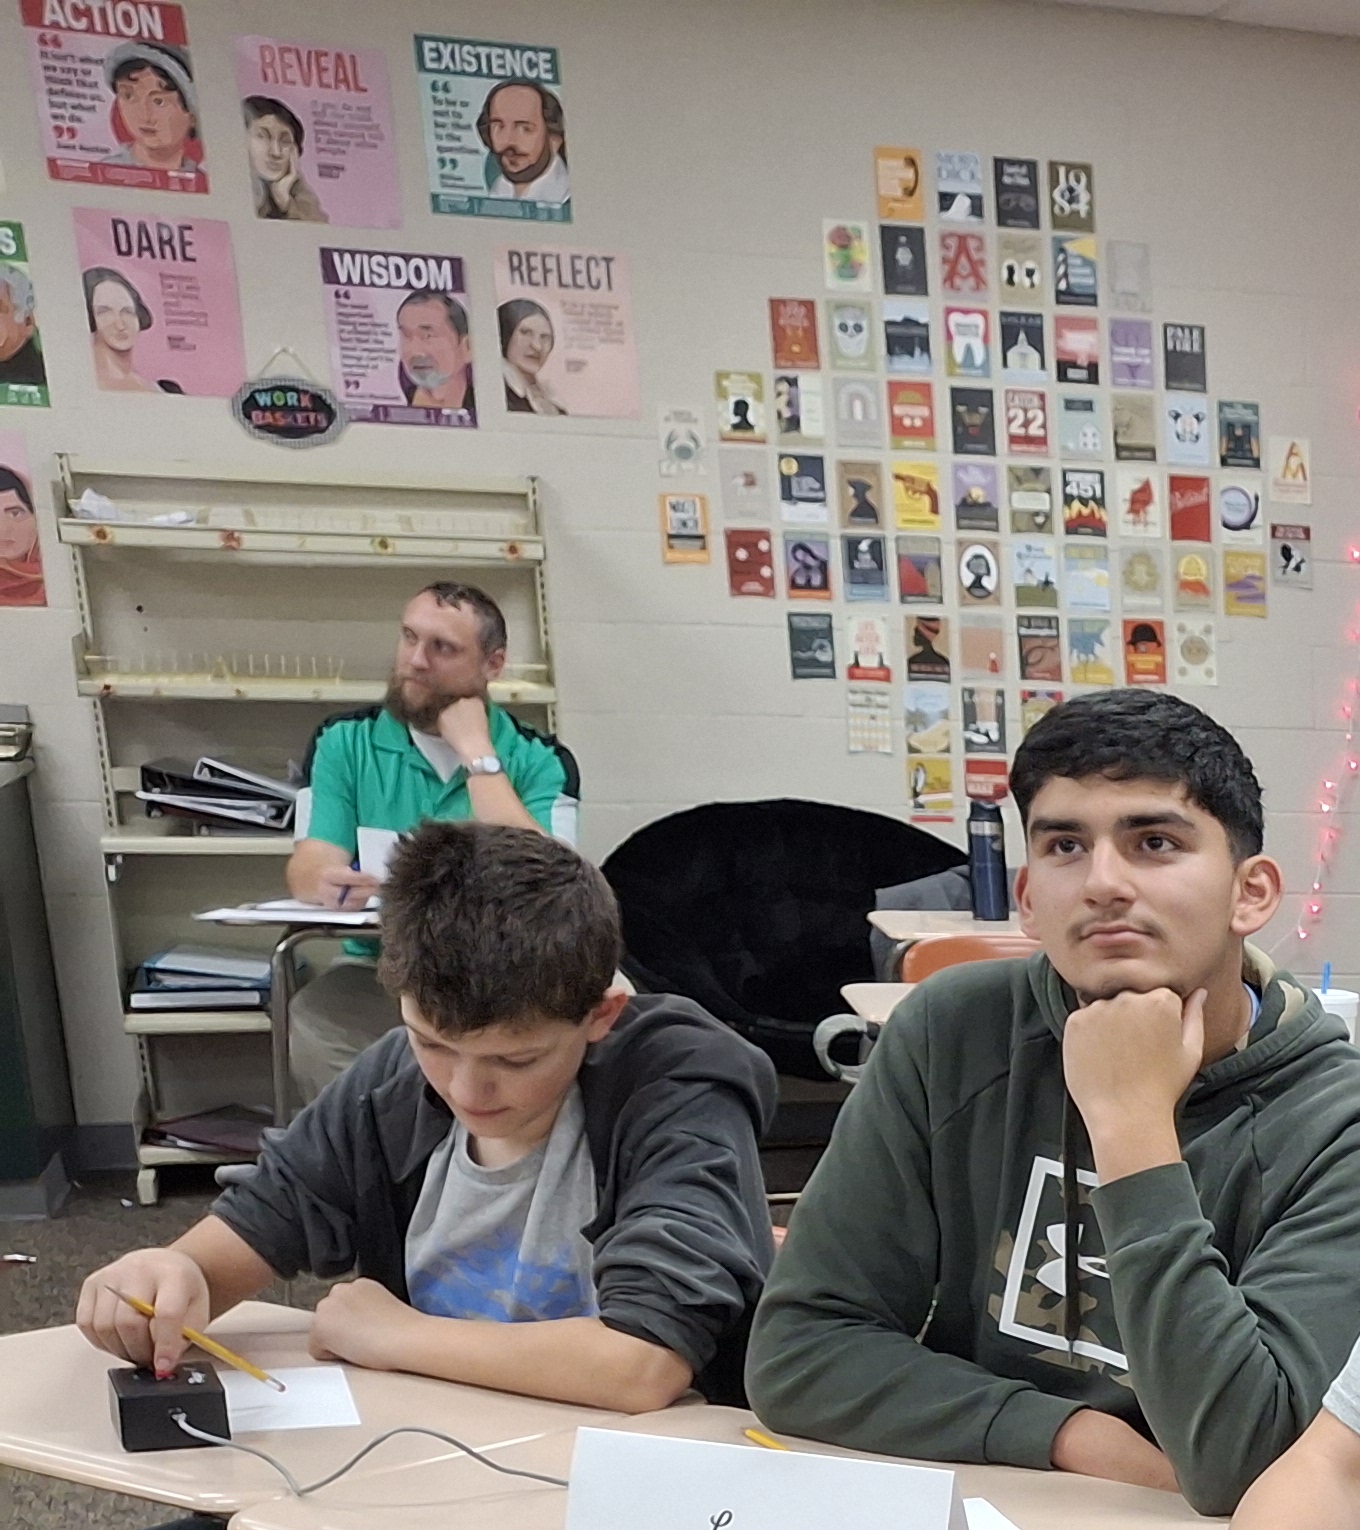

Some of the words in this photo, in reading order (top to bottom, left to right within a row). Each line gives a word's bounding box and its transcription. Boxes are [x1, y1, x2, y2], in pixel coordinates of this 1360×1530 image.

[44, 0, 164, 40] ACTION
[259, 44, 368, 92] REVEAL
[422, 40, 554, 79] EXISTENCE
[111, 218, 197, 263] DARE
[332, 251, 454, 290] WISDOM
[507, 249, 615, 291] REFLECT
[254, 390, 312, 408] WORK
[1008, 407, 1046, 437] 22
[1066, 480, 1102, 499] 451
